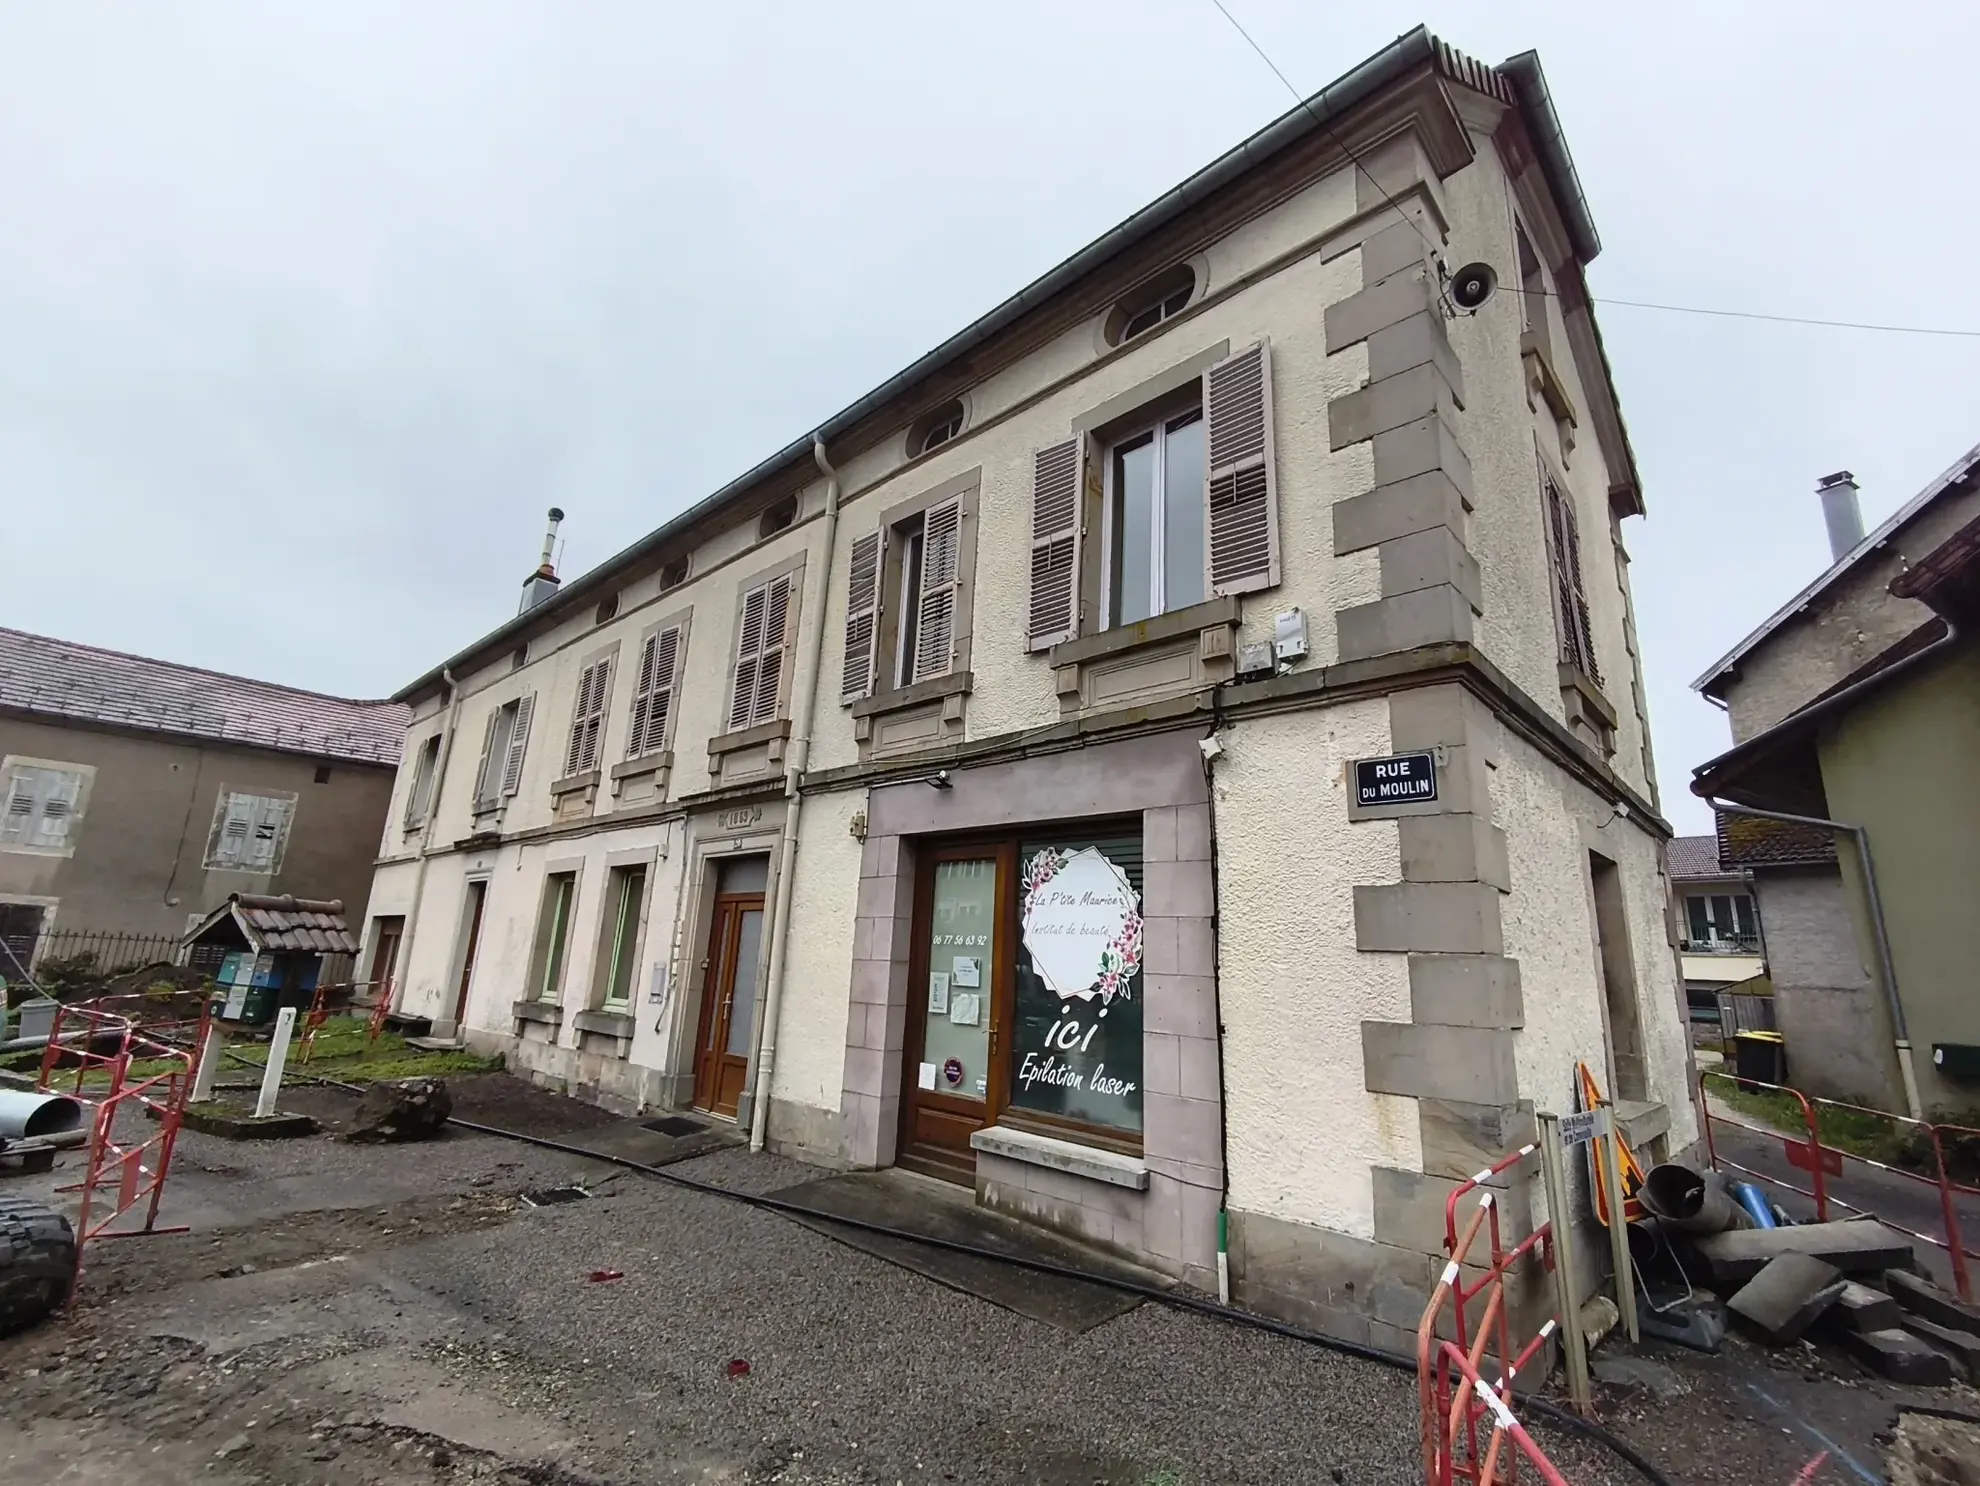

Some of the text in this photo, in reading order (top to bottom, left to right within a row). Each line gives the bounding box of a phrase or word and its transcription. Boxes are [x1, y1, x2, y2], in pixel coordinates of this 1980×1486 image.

[1376, 761, 1411, 778] RUE
[1362, 779, 1429, 798] DU MOULIN
[1035, 893, 1046, 906] La
[1079, 890, 1118, 906] Maurice
[1031, 922, 1110, 937] Institut de beauté
[933, 934, 988, 947] 06 77 56 63 92
[1044, 1004, 1108, 1052] ici
[1019, 1052, 1084, 1092] Epilation
[1090, 1063, 1137, 1097] laser
